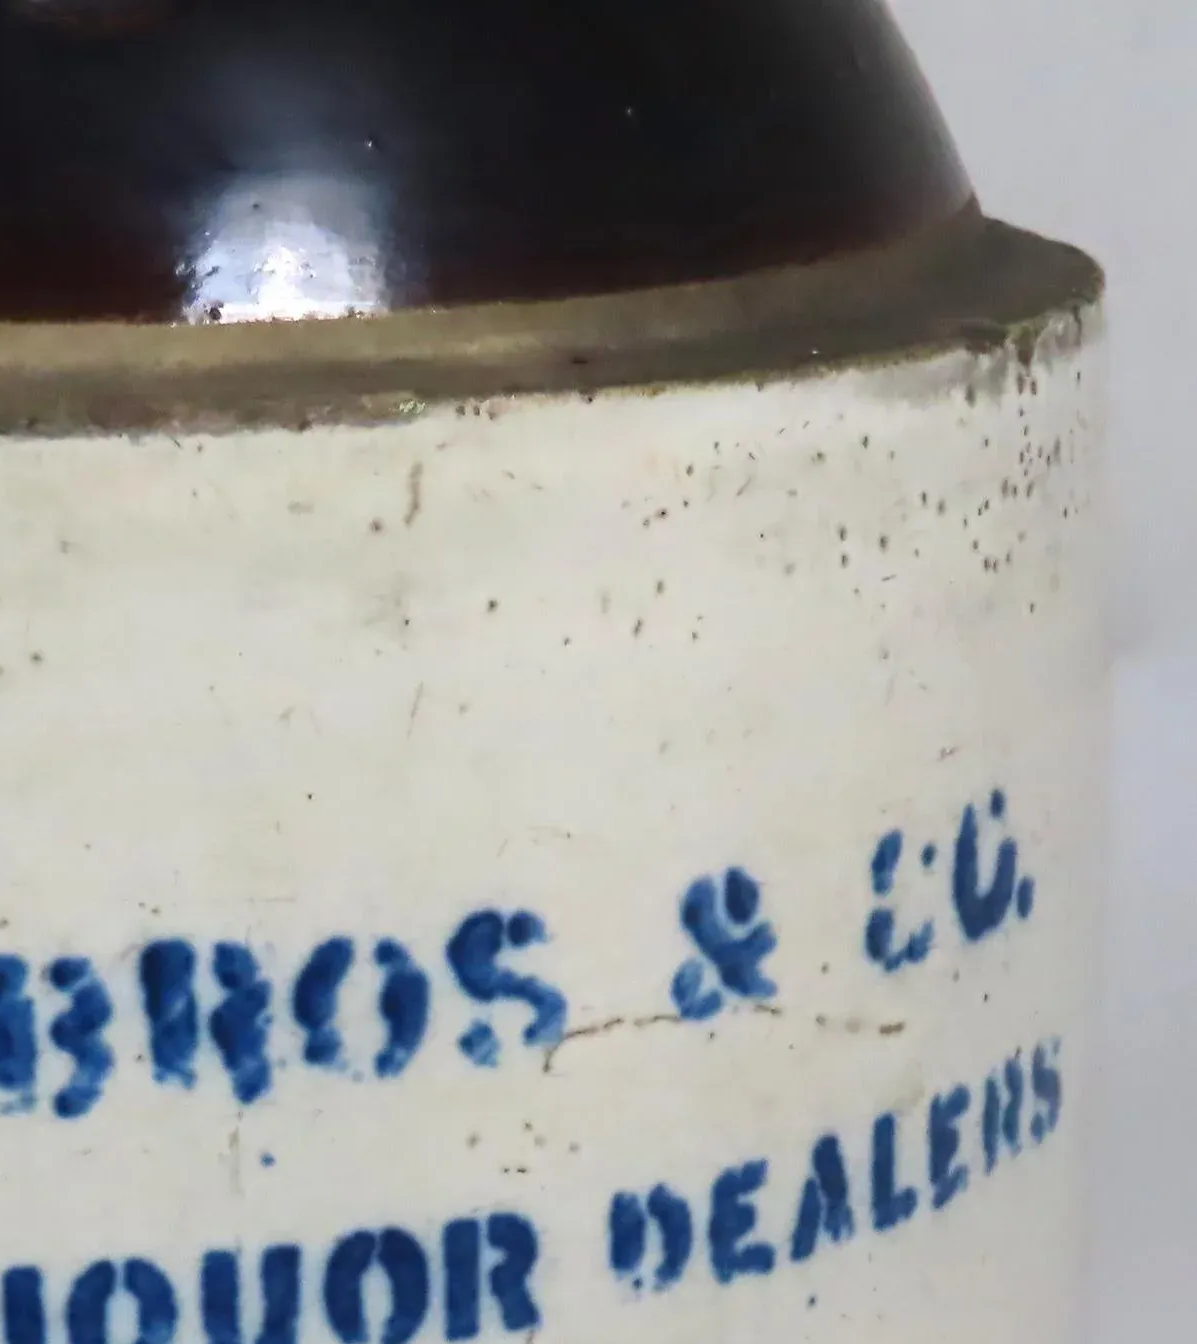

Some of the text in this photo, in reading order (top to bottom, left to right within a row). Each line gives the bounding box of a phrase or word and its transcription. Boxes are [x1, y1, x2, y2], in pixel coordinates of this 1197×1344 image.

[670, 868, 778, 1020] &
[864, 789, 1035, 972] CO.
[608, 1036, 1063, 1290] DEALERS
